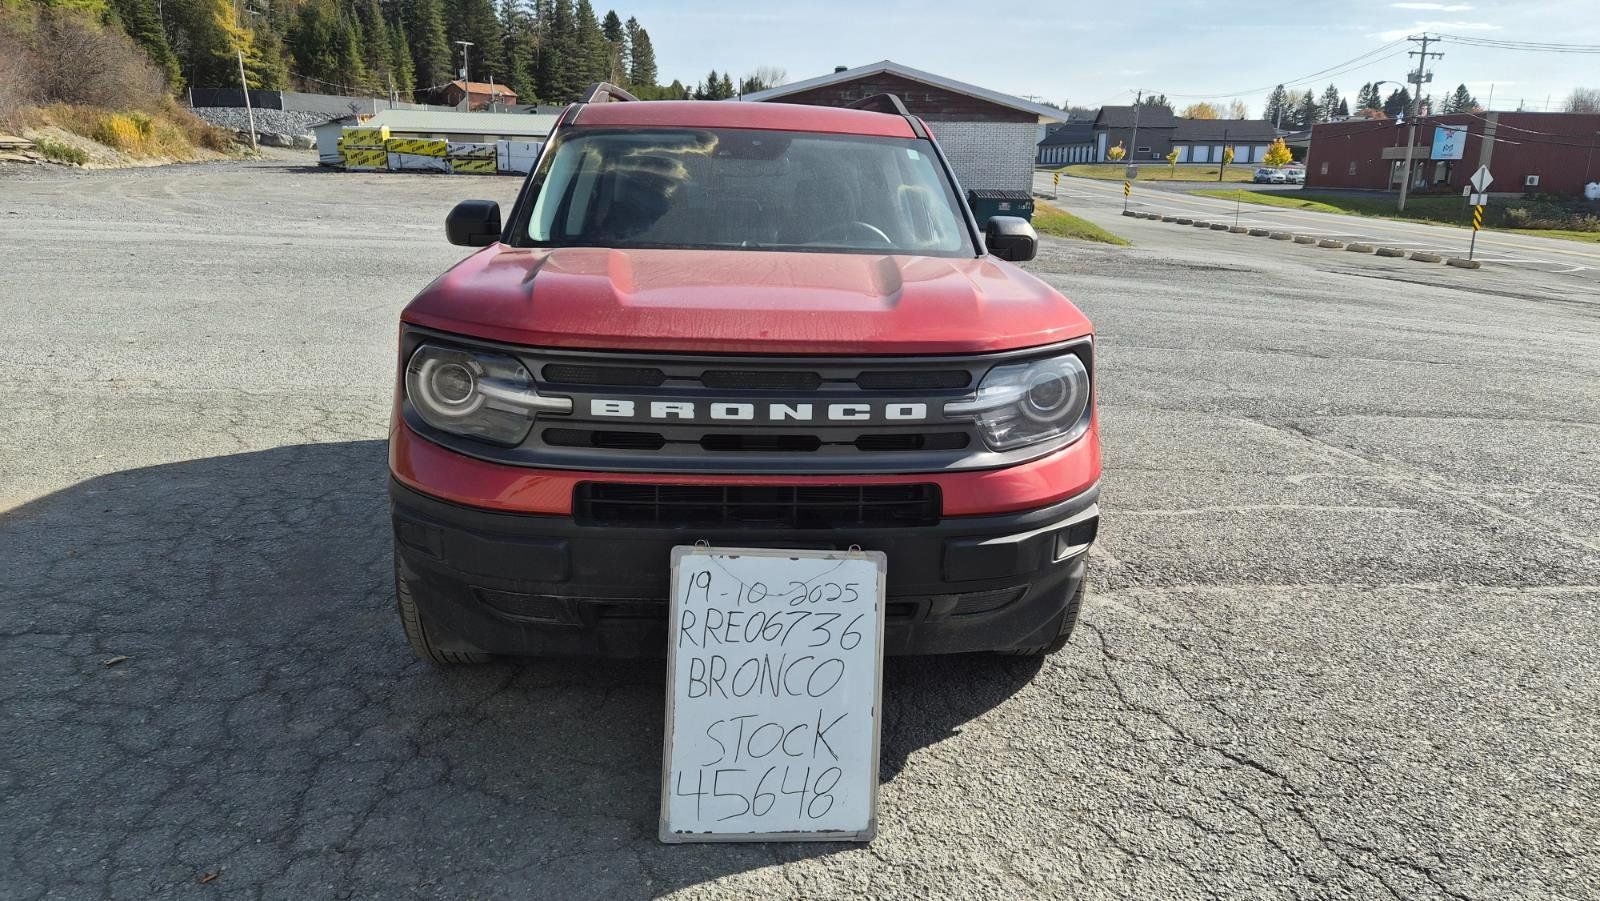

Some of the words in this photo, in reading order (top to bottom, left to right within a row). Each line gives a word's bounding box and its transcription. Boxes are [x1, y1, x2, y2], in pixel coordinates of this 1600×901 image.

[590, 399, 927, 420] BRONCO
[679, 608, 864, 650] RRE06736
[688, 653, 845, 699] BRONCO
[702, 708, 849, 767] STOCK
[676, 766, 842, 821] 45648
